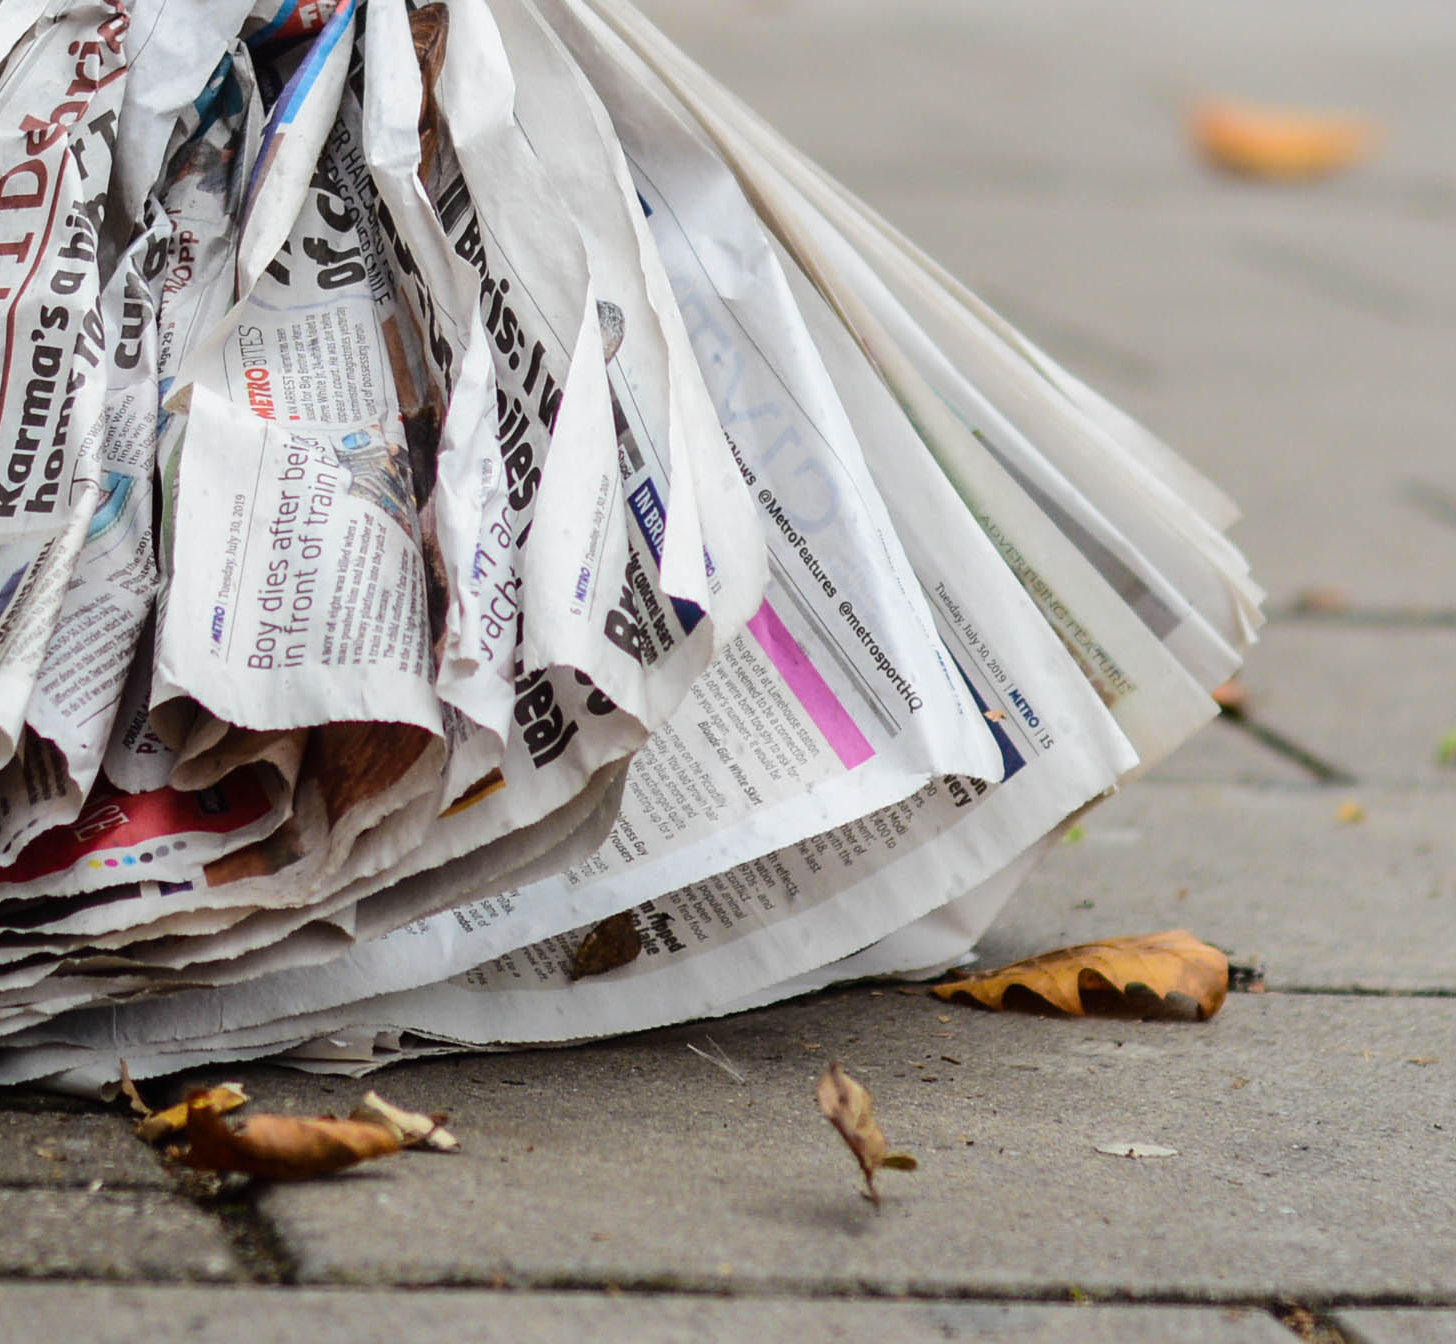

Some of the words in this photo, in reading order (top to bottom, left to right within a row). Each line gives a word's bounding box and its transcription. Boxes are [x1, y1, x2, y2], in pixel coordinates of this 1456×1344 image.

[50, 270, 86, 295] a
[161, 332, 173, 345] 29
[238, 324, 276, 418] METROBITES
[359, 345, 373, 387] possessing
[282, 376, 296, 404] ARREST
[317, 380, 327, 403] White
[107, 440, 121, 460] Cup
[117, 440, 133, 462] final
[232, 494, 245, 517] 2019
[305, 473, 337, 525] train
[635, 486, 653, 514] IN
[229, 520, 242, 534] 30,
[269, 490, 300, 550] after
[225, 535, 241, 556] July
[298, 535, 323, 560] of
[218, 558, 237, 598] Tuesday,
[257, 559, 289, 612] dies
[335, 575, 345, 593] was
[575, 567, 590, 602] METRO
[283, 568, 318, 634] front
[758, 489, 837, 598] @MetroFeatures
[839, 601, 923, 714] @metrosportHQ
[975, 514, 1068, 620] ADVERTISING
[1067, 620, 1135, 694] FEATURE
[211, 606, 225, 643] METRO
[326, 622, 336, 632] of
[247, 621, 285, 669] Boy
[277, 644, 305, 668] in
[322, 635, 333, 656] BOY
[733, 633, 745, 652] You
[740, 650, 756, 665] got
[752, 664, 766, 677] off
[760, 677, 772, 688] at
[767, 686, 801, 729] Limehouse
[935, 582, 965, 626] Tuesday,
[963, 624, 979, 645] July
[986, 658, 1007, 683] 2019
[1009, 689, 1039, 728] METRO
[1039, 734, 1054, 749] 15
[690, 685, 704, 699] see
[698, 698, 714, 714] you
[735, 666, 762, 698] seemed
[756, 697, 767, 708] to
[762, 706, 774, 718] be
[774, 724, 808, 765] connection
[706, 680, 729, 707] other's
[753, 748, 776, 770] would
[769, 768, 781, 780] be
[716, 668, 728, 679] we
[725, 680, 742, 699] were
[738, 698, 755, 716] both
[751, 716, 764, 731] too
[759, 730, 773, 744] shy
[769, 743, 780, 753] to
[776, 753, 789, 766] ask
[672, 735, 685, 752] man
[681, 752, 693, 762] on
[689, 761, 703, 775] the
[699, 773, 727, 808] Piccadilly
[697, 721, 720, 747] Blonde
[729, 764, 748, 786] White
[744, 786, 763, 805] Skirt
[640, 772, 675, 812] exchanged
[668, 812, 686, 830] quite
[653, 764, 669, 781] blue
[665, 781, 686, 804] shorts
[681, 804, 697, 818] and
[667, 754, 679, 770] You
[676, 770, 693, 785] had
[686, 784, 707, 806] brown
[705, 806, 719, 820] hair
[632, 782, 655, 813] meeting
[650, 812, 661, 823] up
[658, 822, 671, 832] for
[888, 811, 906, 835] Modi
[633, 841, 647, 856] Guy
[839, 850, 853, 866] the
[853, 845, 866, 856] of
[885, 836, 896, 848] to
[774, 863, 799, 897] reflects
[805, 854, 821, 873] last
[723, 869, 751, 902] conflict
[757, 894, 775, 910] and
[480, 900, 499, 918] same
[677, 904, 695, 921] find
[693, 902, 712, 923] been
[697, 884, 733, 928] population
[718, 886, 747, 919] animal
